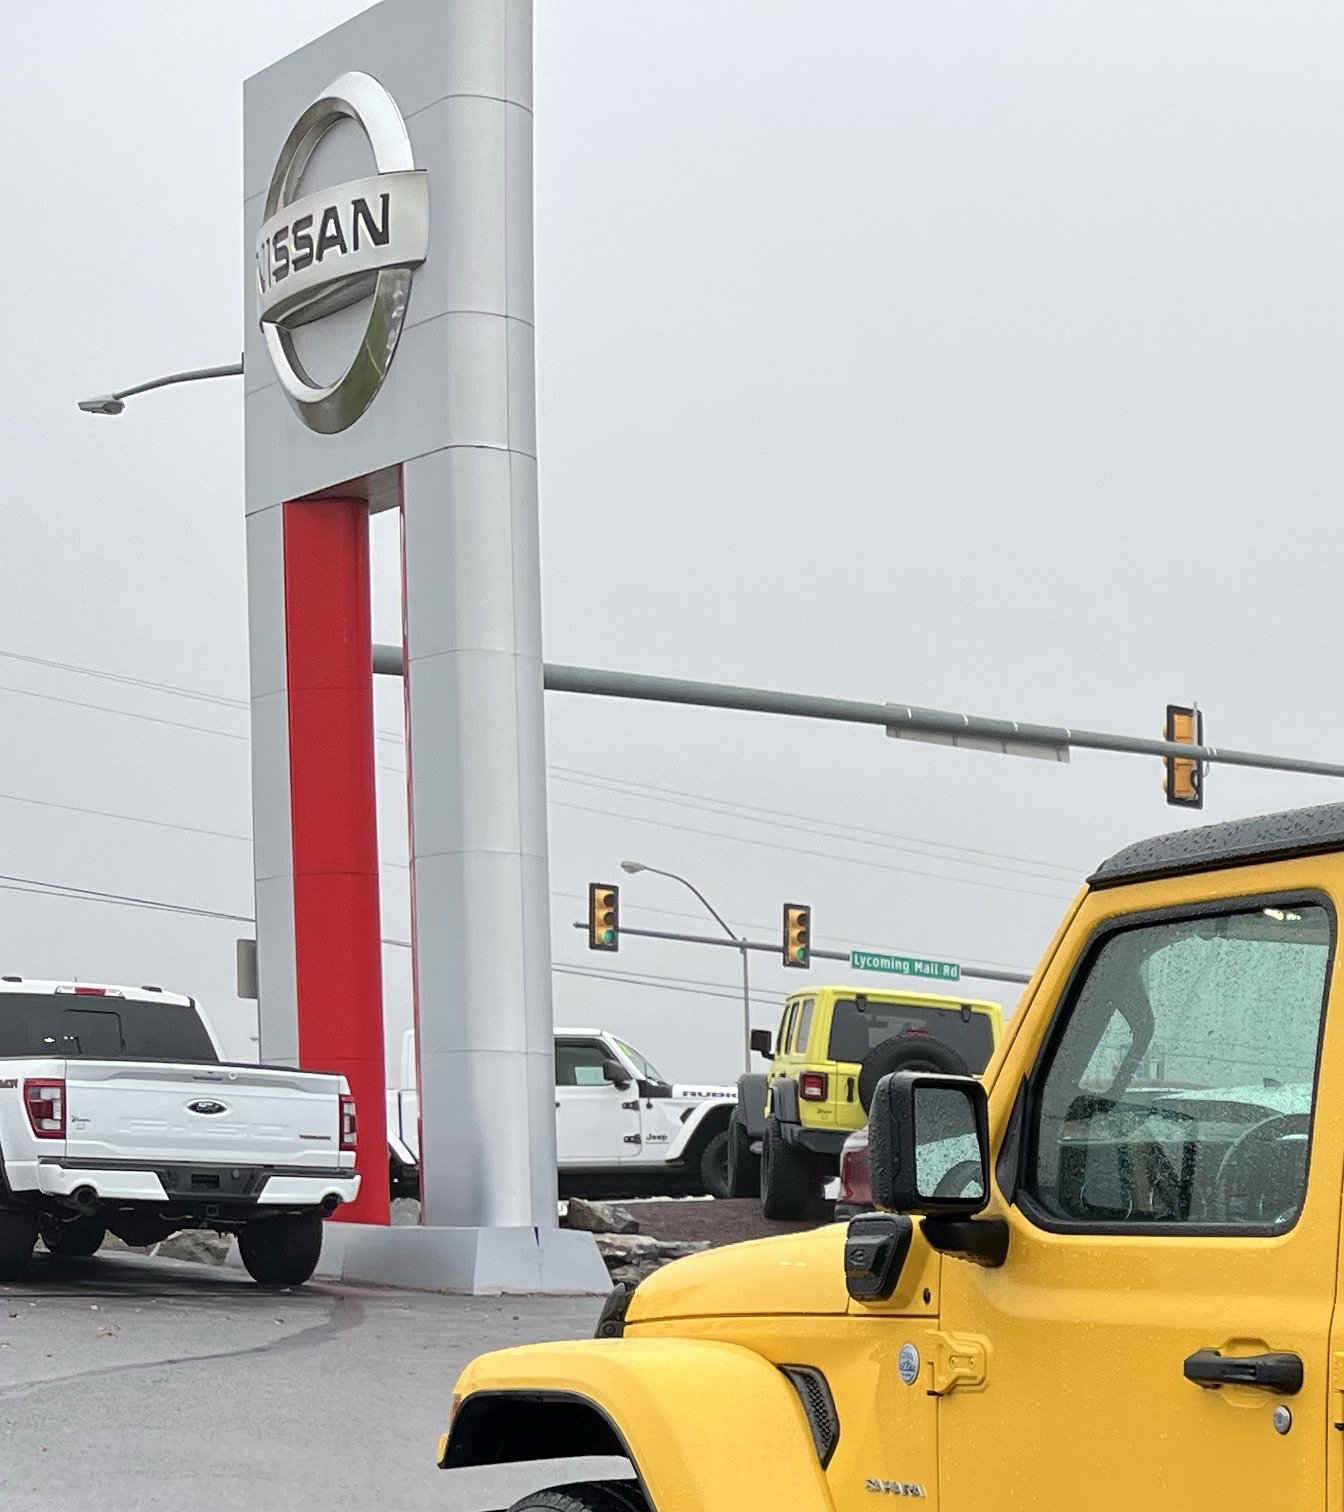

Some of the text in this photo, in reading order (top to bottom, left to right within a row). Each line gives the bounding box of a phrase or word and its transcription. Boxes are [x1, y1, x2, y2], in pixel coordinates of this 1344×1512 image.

[256, 193, 390, 293] NISSAN
[854, 953, 958, 978] Lycoming Mall Rd
[865, 1478, 927, 1498] SAHARA
